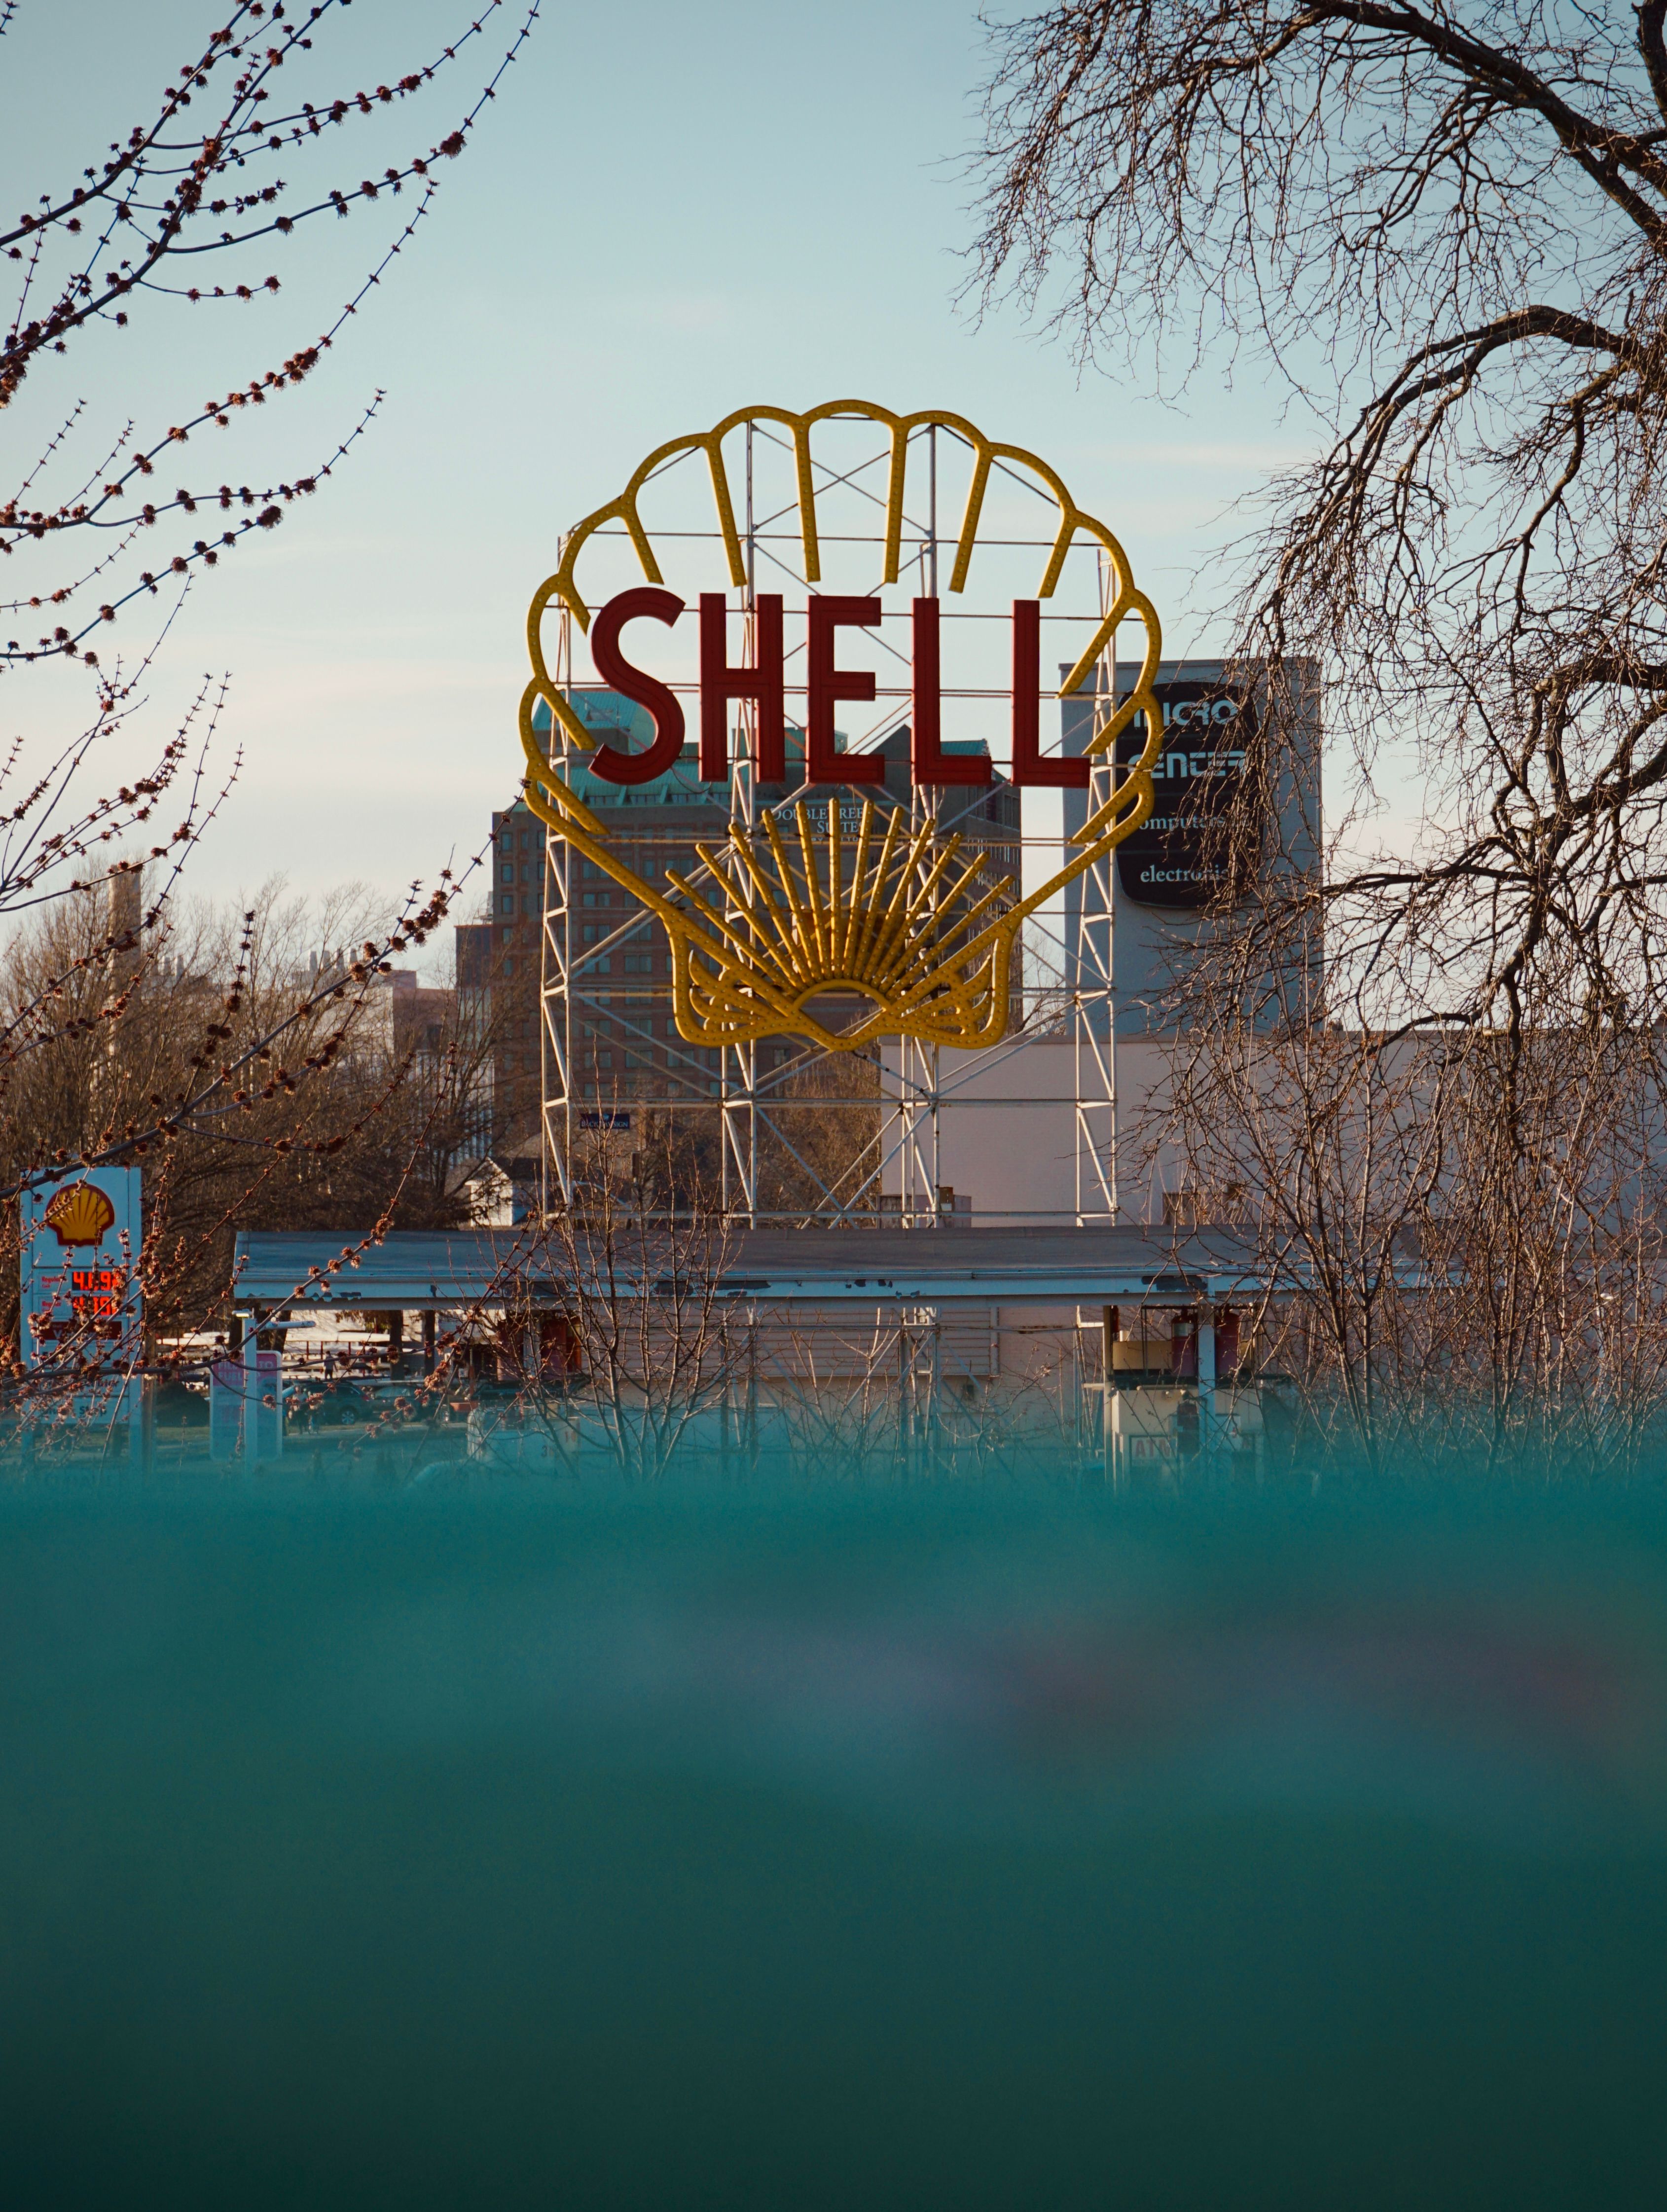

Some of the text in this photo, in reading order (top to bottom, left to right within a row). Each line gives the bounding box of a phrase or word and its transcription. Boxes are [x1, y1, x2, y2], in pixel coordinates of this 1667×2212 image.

[588, 587, 1090, 788] SHELL
[1134, 699, 1239, 727] ICRO
[770, 806, 864, 821] DOUBLEREE
[817, 821, 862, 834] STE
[1138, 815, 1227, 834] omputers
[1140, 864, 1232, 882] electronic
